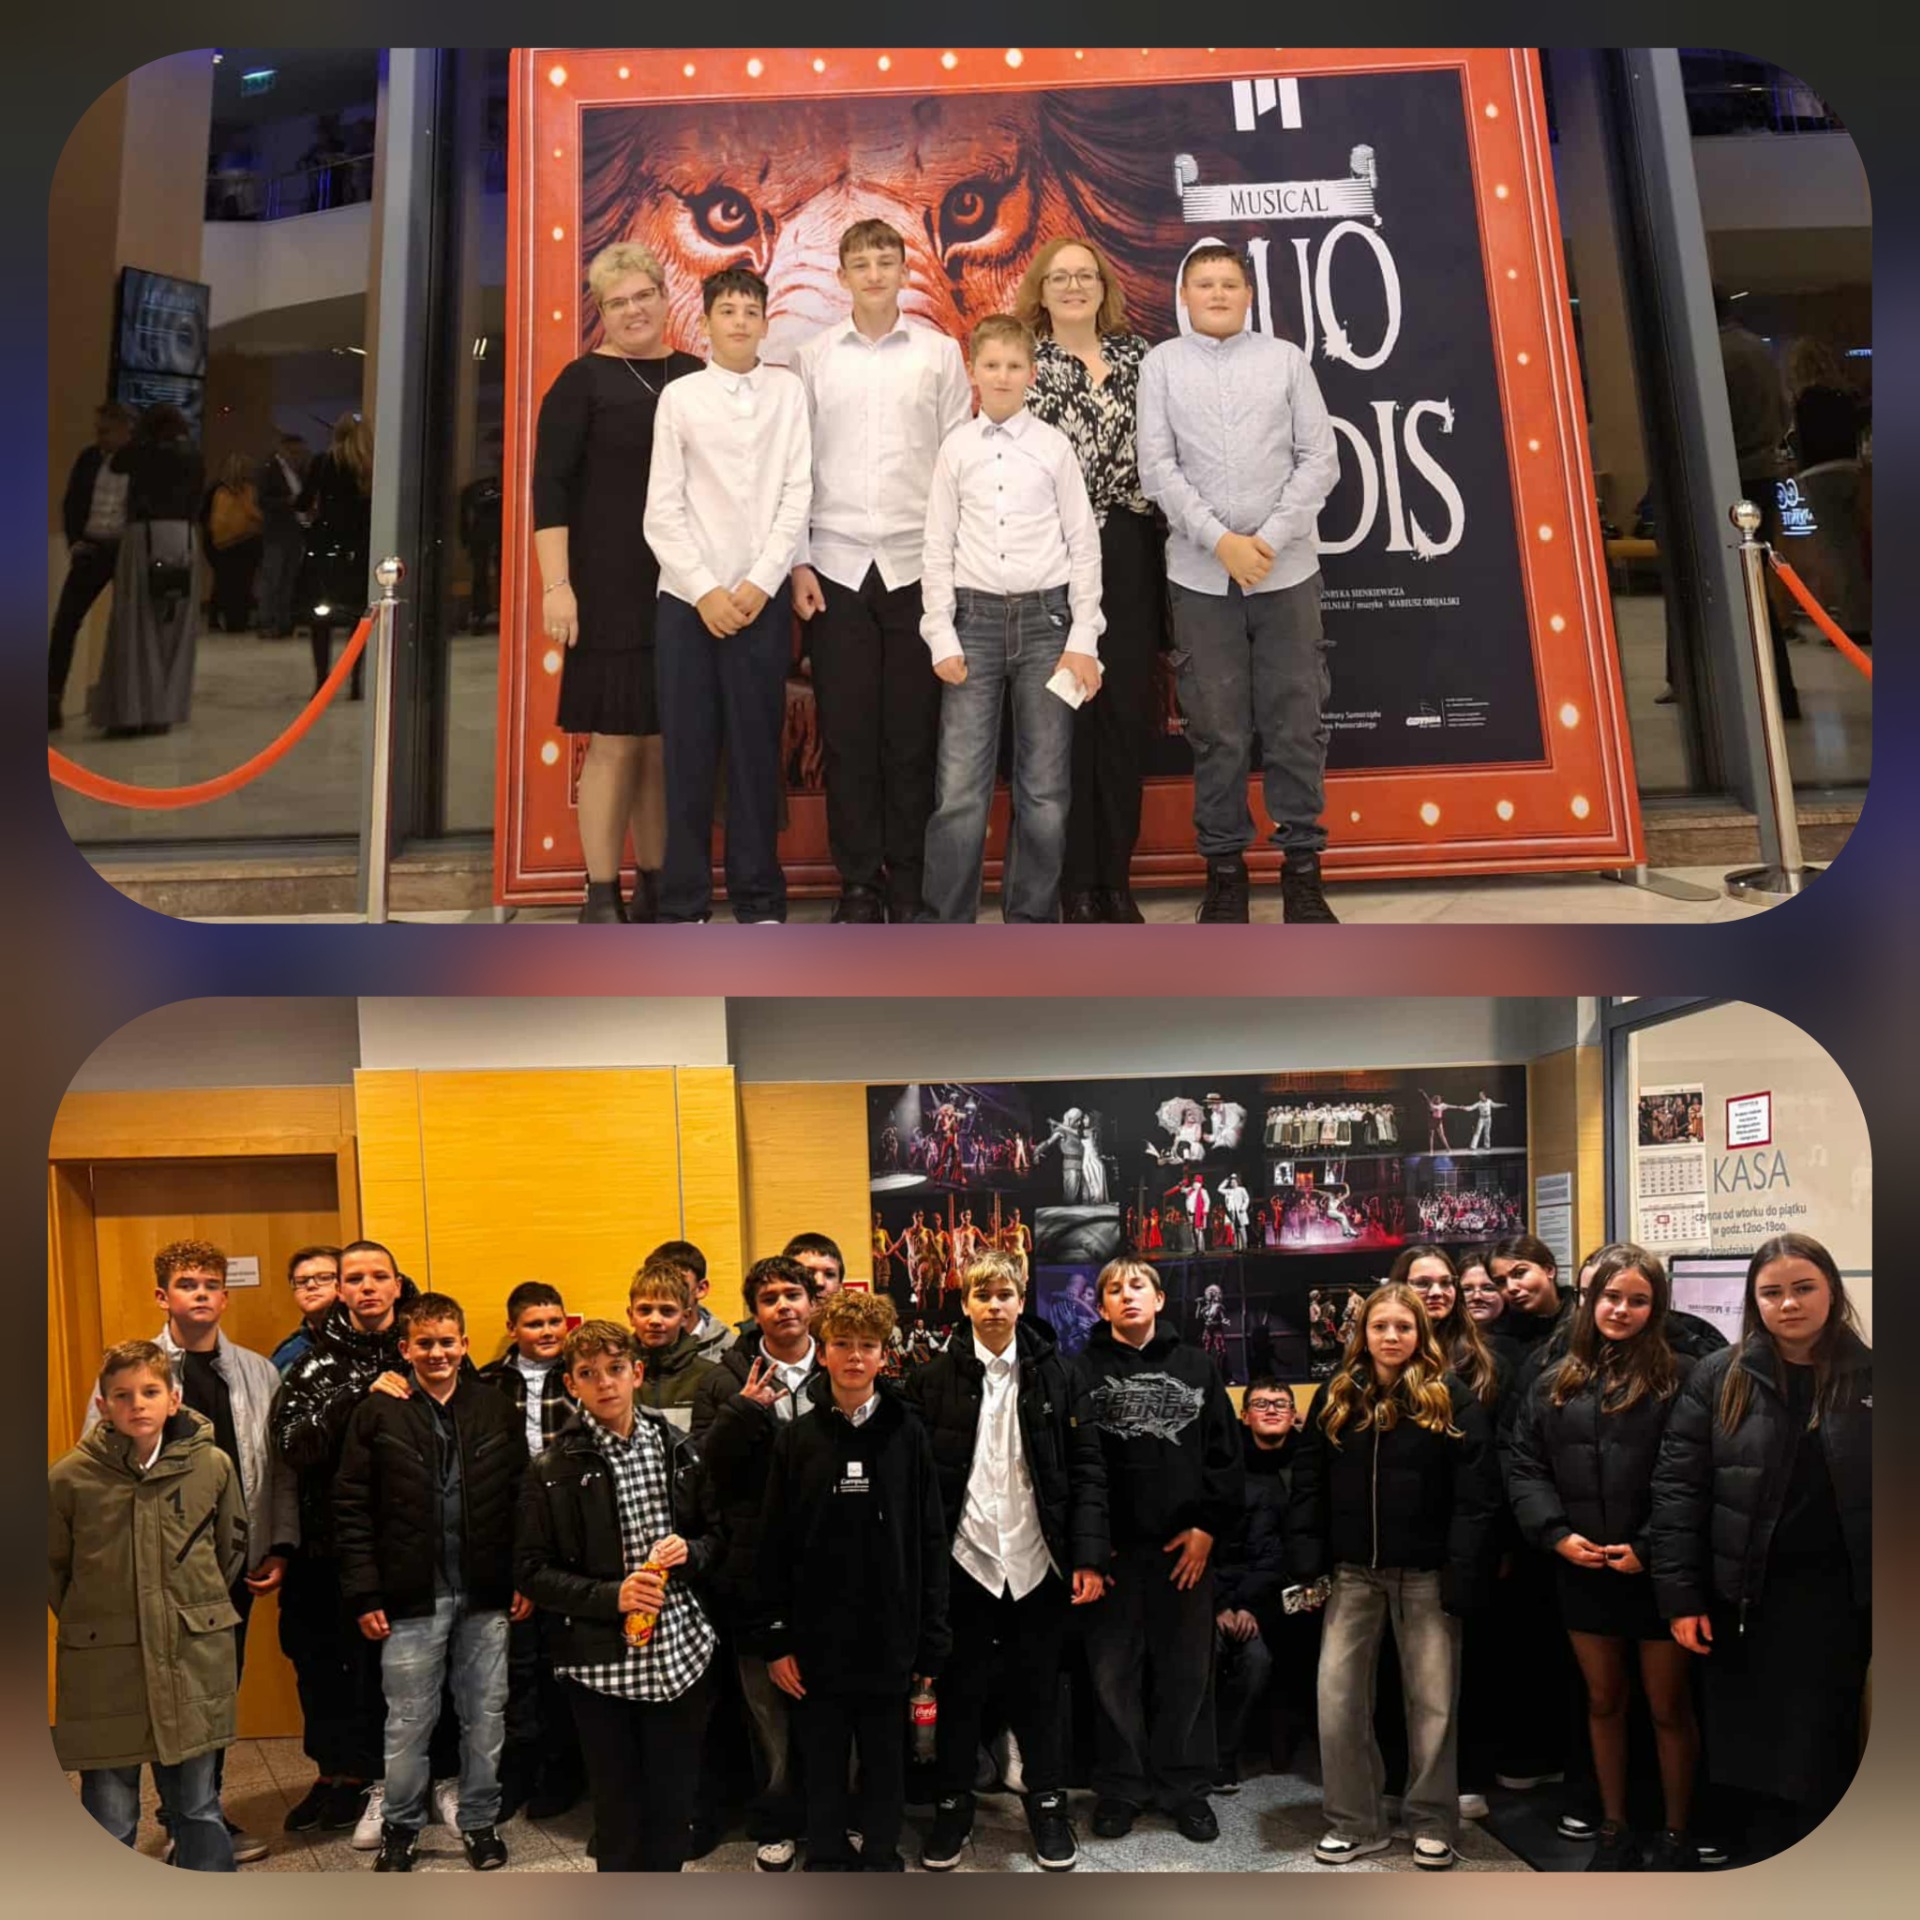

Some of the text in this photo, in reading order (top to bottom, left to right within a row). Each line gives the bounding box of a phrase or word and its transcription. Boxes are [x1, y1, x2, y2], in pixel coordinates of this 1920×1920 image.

[1230, 188, 1329, 216] MUSICAL
[1316, 395, 1466, 562] DIS
[1356, 600, 1383, 611] muzyka
[1388, 598, 1421, 608] MARIUSZ
[1714, 1150, 1790, 1194] KASA
[1723, 1205, 1734, 1220] od
[1736, 1206, 1764, 1219] wtorku
[1765, 1204, 1778, 1217] do
